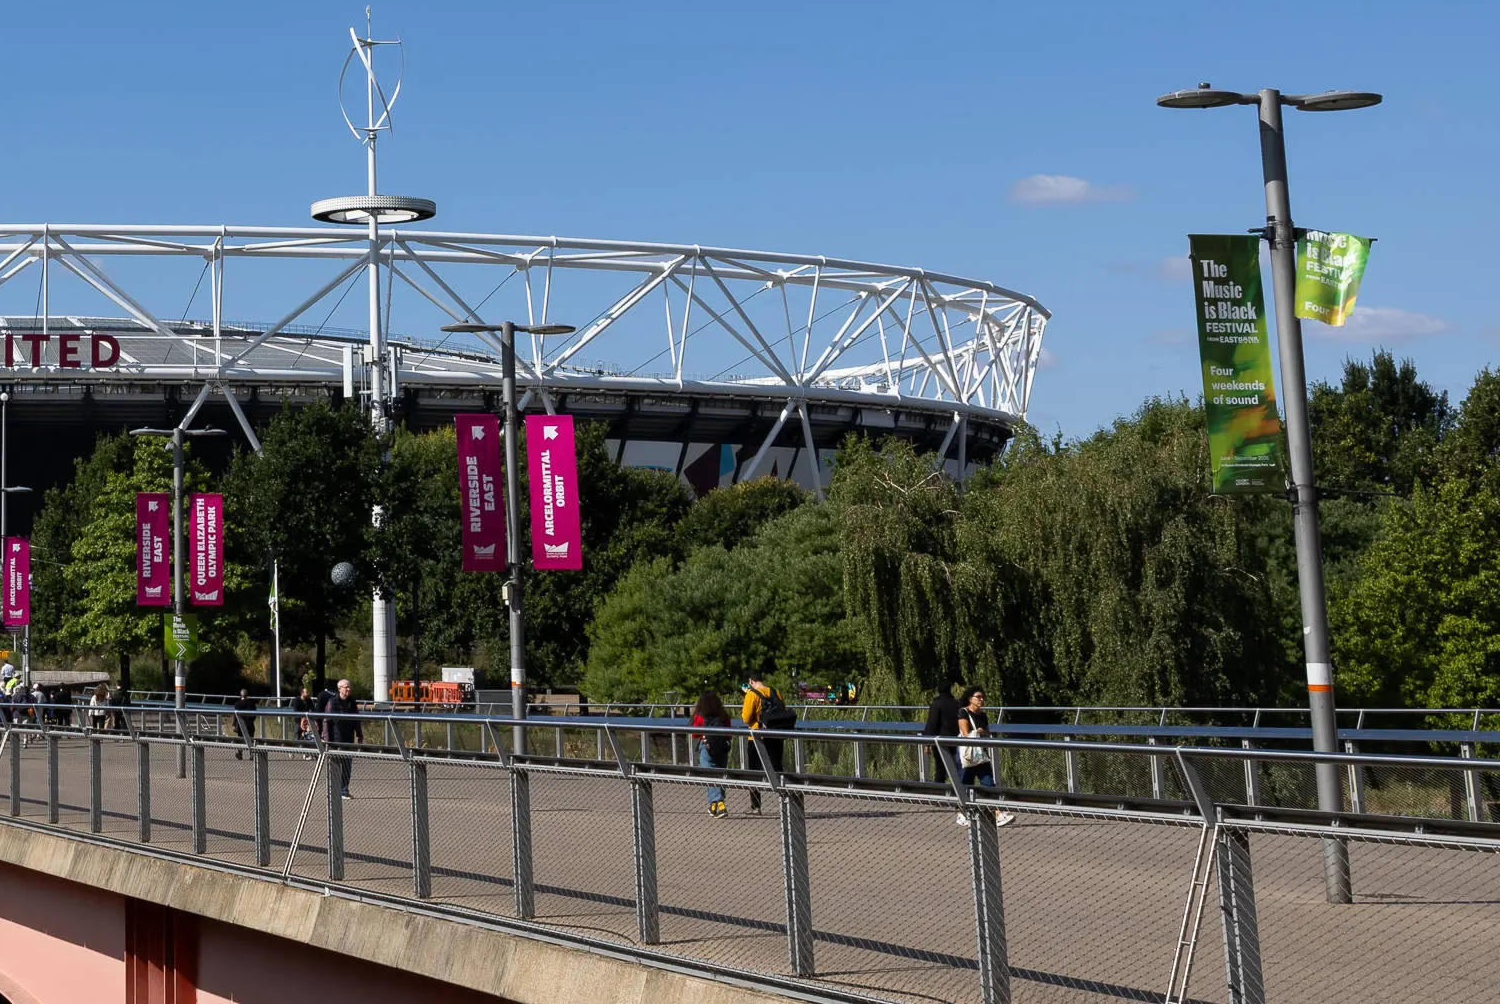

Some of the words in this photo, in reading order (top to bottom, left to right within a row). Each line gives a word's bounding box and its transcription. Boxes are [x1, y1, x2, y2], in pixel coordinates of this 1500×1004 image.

[1200, 259, 1228, 278] The
[1202, 281, 1243, 299] Music
[1204, 301, 1218, 319] is
[1218, 301, 1258, 320] Black
[1304, 301, 1329, 316] Four
[1206, 322, 1258, 334] FESTIVAL
[1210, 366, 1234, 377] Four
[1212, 379, 1265, 391] weekends
[1213, 394, 1224, 405] of
[1225, 394, 1259, 405] sound
[466, 456, 481, 533] RIVERSIDE
[482, 474, 496, 512] EAST
[541, 449, 555, 536] ARCELORMITTAL
[555, 475, 566, 508] ORBIT
[196, 498, 206, 550] ELIZABETH
[207, 506, 216, 533] PARK
[143, 523, 151, 578] RIVERSIDE
[154, 536, 163, 563] EAST
[207, 534, 217, 578] OLYMPIC
[196, 551, 206, 586] QUEEN
